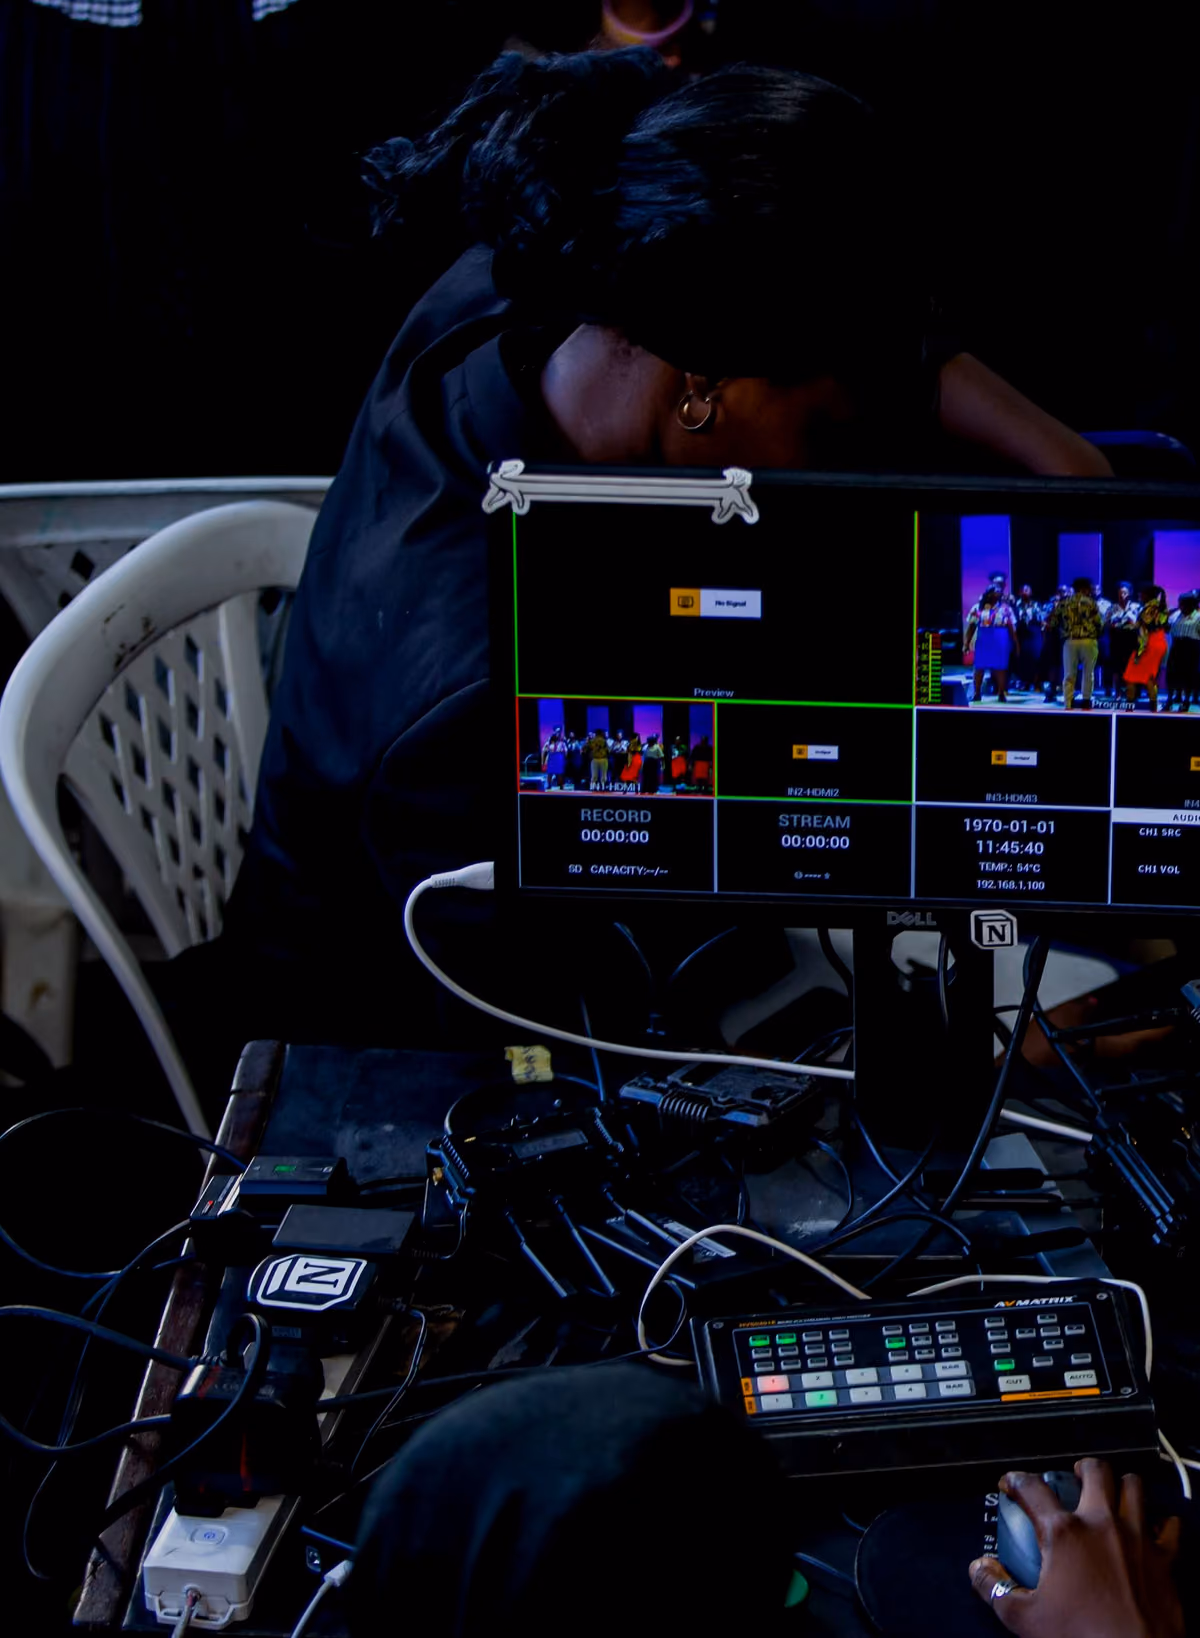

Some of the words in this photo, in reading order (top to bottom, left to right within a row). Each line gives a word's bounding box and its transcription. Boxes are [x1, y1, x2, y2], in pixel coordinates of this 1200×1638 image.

[727, 600, 747, 609] Signal
[694, 687, 734, 698] Preview
[1091, 699, 1136, 712] Program
[589, 781, 641, 793] IN1-HDMI1
[787, 787, 840, 797] IN2-HDMI2
[985, 793, 1038, 803] IN3-HDMI3
[580, 808, 652, 824] RECORD
[778, 814, 851, 829] STREAM
[963, 817, 1056, 834] 1970-01-01
[581, 828, 649, 844] 00:00:00
[1138, 827, 1158, 837] CH1
[1162, 828, 1181, 838] SRC
[781, 834, 850, 849] 00:00:00
[976, 839, 1044, 855] 11:45:40
[568, 864, 583, 874] SD
[1138, 864, 1158, 874] CH1
[1160, 865, 1180, 875] VOL
[976, 879, 1045, 891] 192.168.1.100
[886, 910, 937, 927] DELL
[987, 924, 1008, 943] N
[993, 1295, 1075, 1308] AVMATRIX
